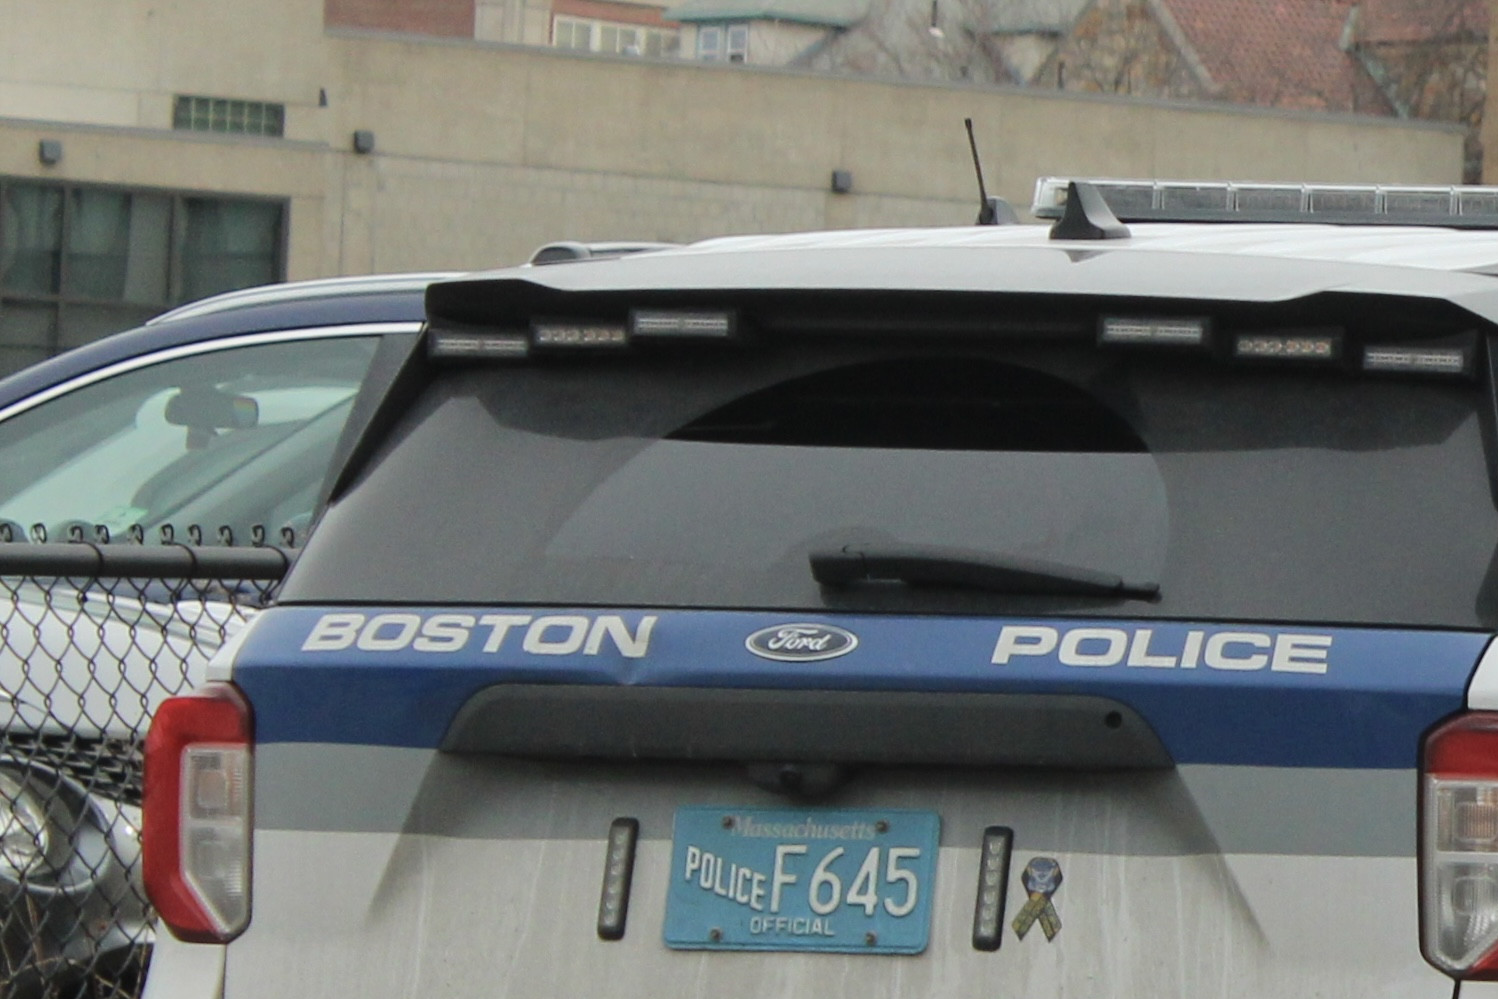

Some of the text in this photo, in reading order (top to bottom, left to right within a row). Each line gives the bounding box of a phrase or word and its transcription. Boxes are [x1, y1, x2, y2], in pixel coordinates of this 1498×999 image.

[301, 612, 657, 658] BOSTON
[768, 624, 832, 652] Ford
[990, 625, 1333, 674] POLICE
[731, 816, 876, 839] Massachusetts
[685, 846, 767, 912] POLICE
[770, 844, 921, 917] F645
[750, 916, 836, 936] OFFICIAL
